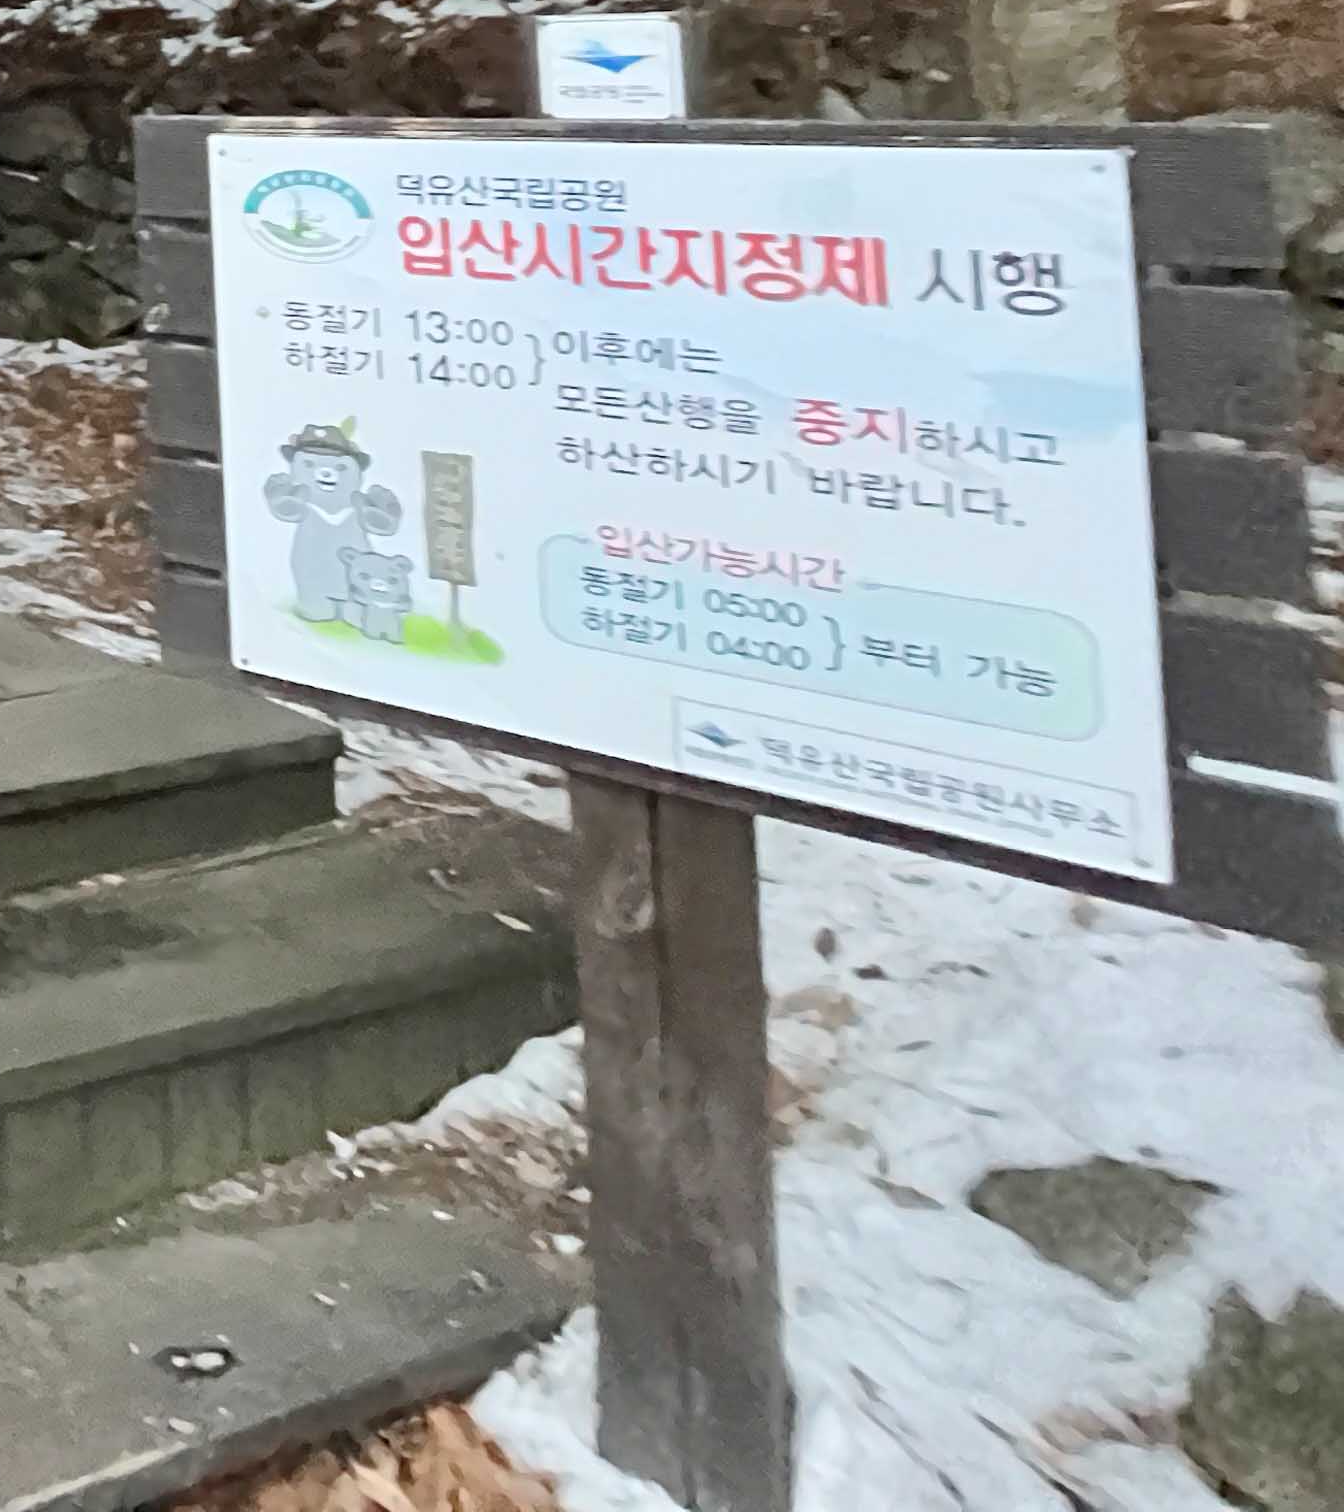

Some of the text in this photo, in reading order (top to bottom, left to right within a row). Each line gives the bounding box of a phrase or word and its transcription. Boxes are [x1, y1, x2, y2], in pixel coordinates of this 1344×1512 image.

[397, 174, 628, 212] 덕유산국립공원
[398, 215, 1066, 317] 입산시간지정제 시행
[281, 301, 514, 346] 동절기 13:00
[553, 330, 724, 374] 이후에는
[282, 341, 517, 390] 하절기 14:00
[556, 437, 1027, 527] 하산하시기 바랍니다.
[596, 524, 847, 594] 입산가능시간
[579, 565, 807, 628] 동절기 05:00
[580, 606, 811, 671] 하절기 04:00
[858, 634, 1059, 697] 부터 가능
